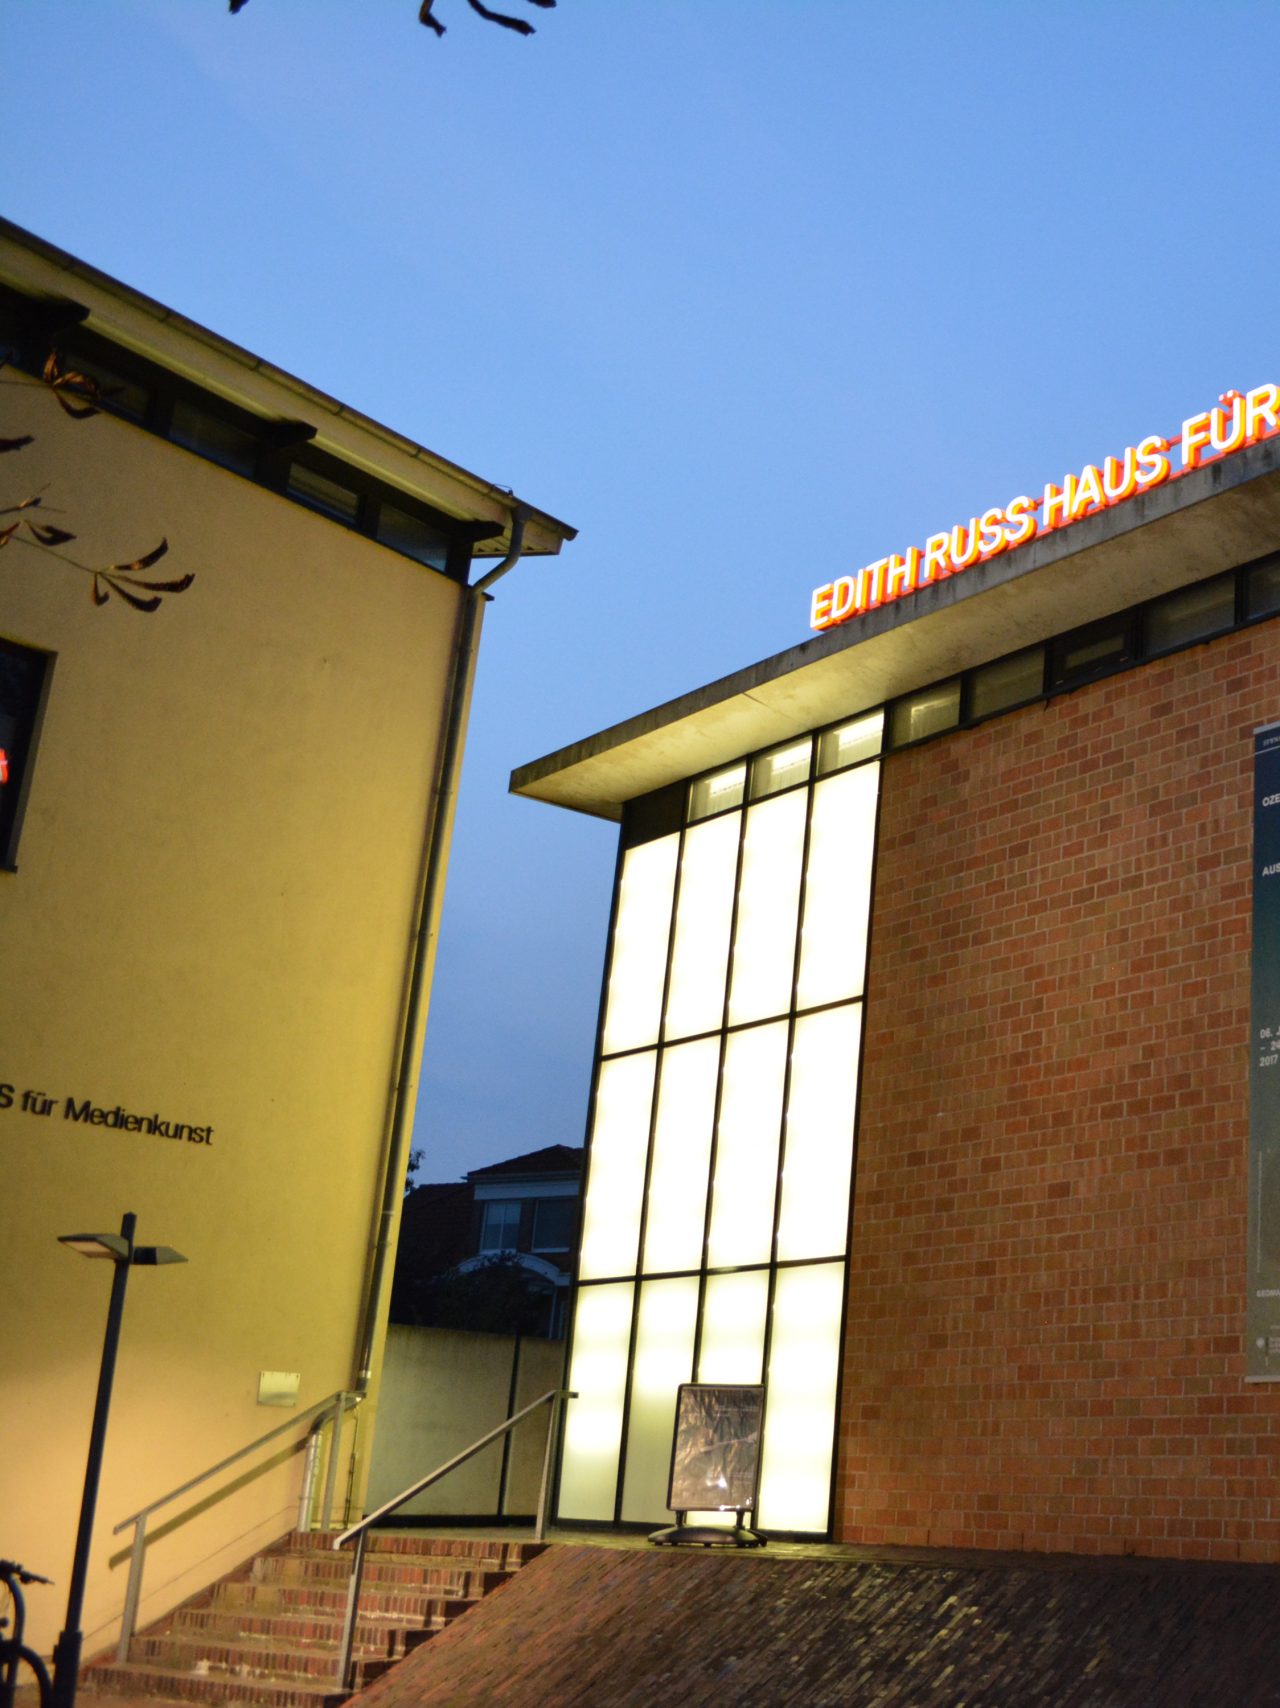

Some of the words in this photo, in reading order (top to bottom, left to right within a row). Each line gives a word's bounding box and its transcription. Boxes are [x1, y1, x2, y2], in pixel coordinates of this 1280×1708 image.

[810, 546, 921, 630] EDITH
[922, 495, 1037, 581] RUSS
[1041, 436, 1169, 527] HAUS
[21, 1089, 58, 1116] für
[64, 1097, 215, 1145] Medienkunst
